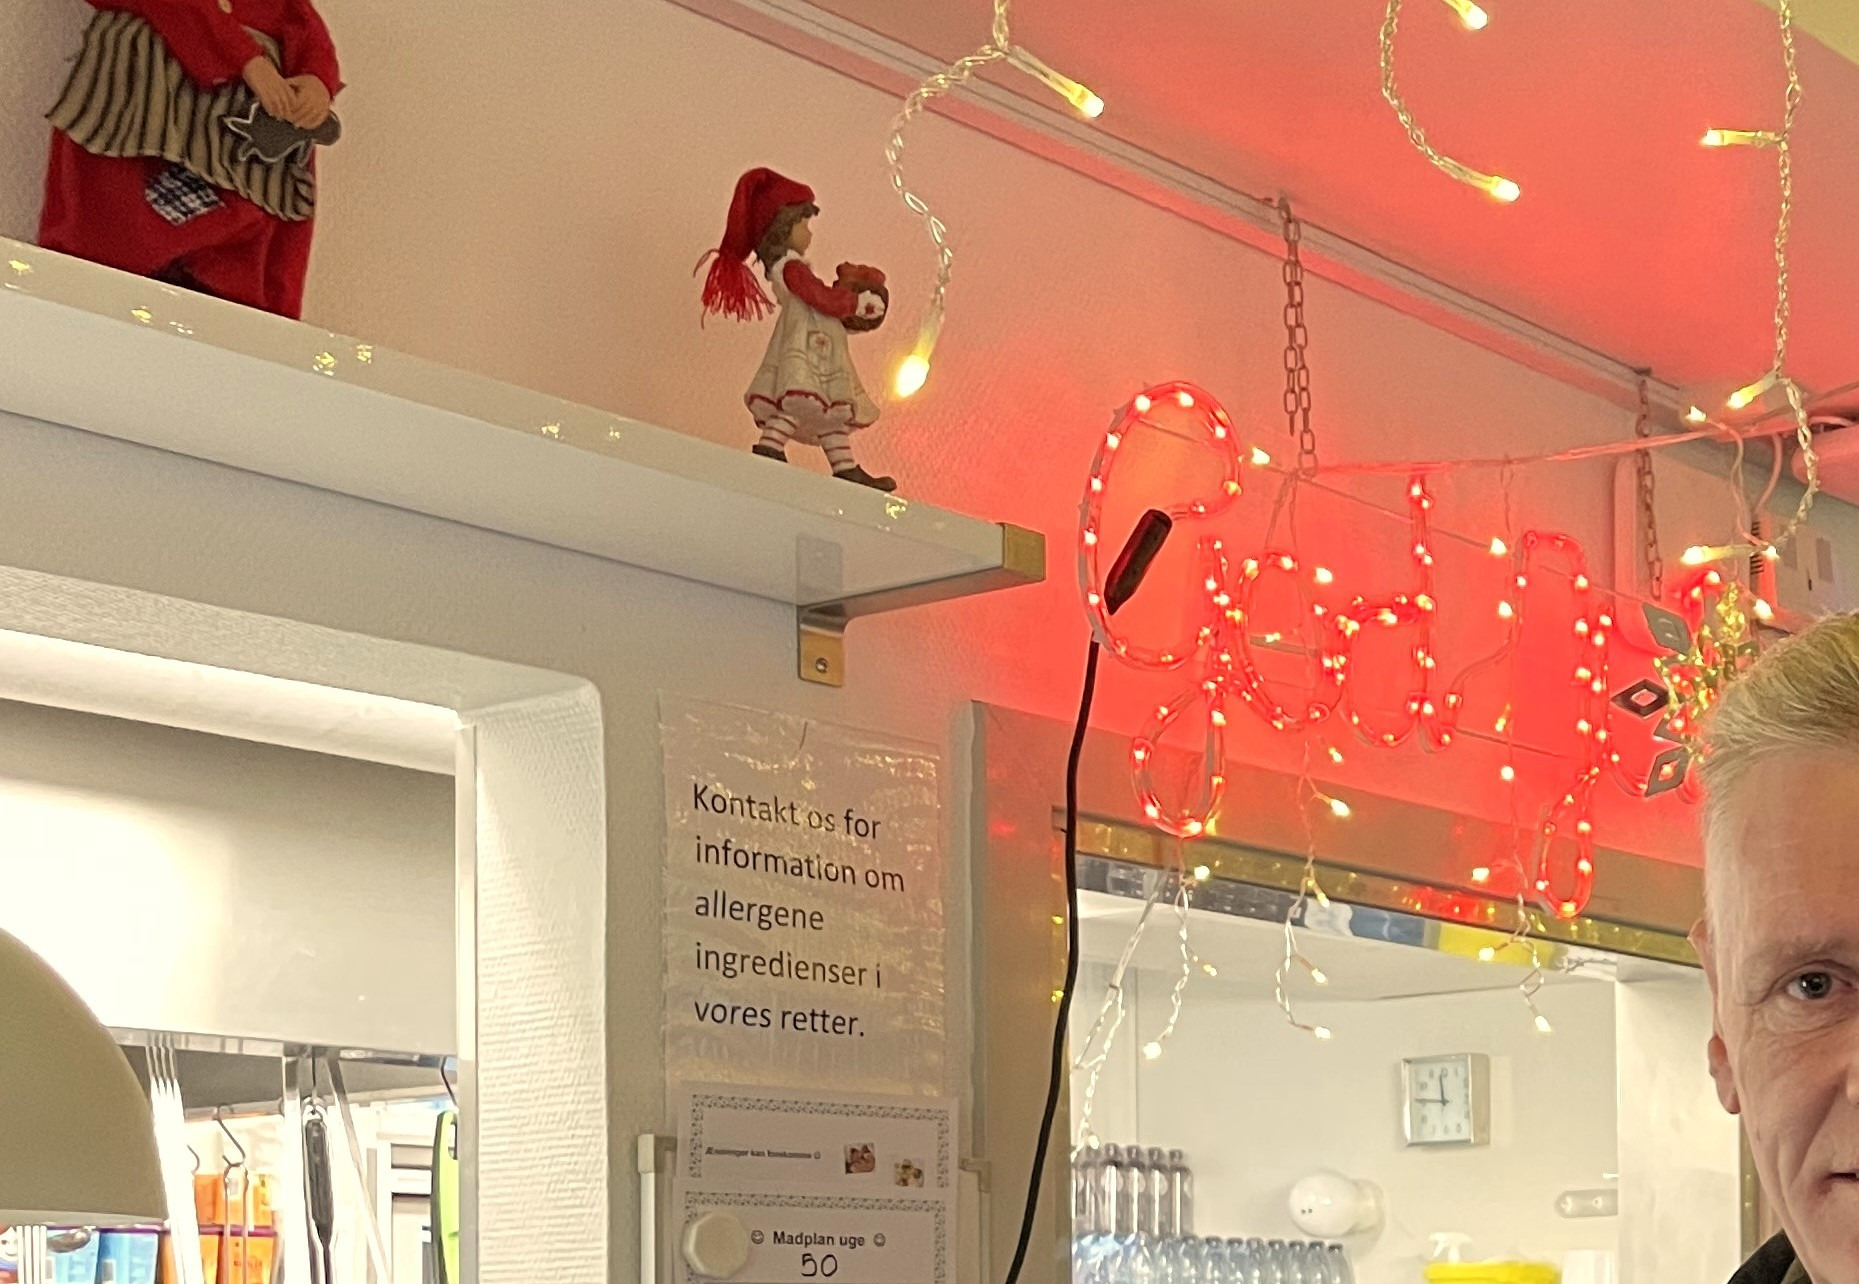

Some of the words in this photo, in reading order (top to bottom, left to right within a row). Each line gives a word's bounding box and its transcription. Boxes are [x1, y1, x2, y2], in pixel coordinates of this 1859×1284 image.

[693, 783, 800, 827] Kontakt
[808, 810, 836, 833] os
[844, 808, 881, 840] for
[696, 836, 856, 886] information
[865, 869, 905, 892] om
[695, 890, 824, 931] allergene
[696, 942, 867, 987] ingredienser
[876, 962, 882, 988] i
[694, 1001, 772, 1029] vores
[781, 1007, 865, 1038] retter.
[773, 1230, 835, 1248] Madplan
[839, 1236, 866, 1249] uge
[801, 1253, 838, 1277] 50
